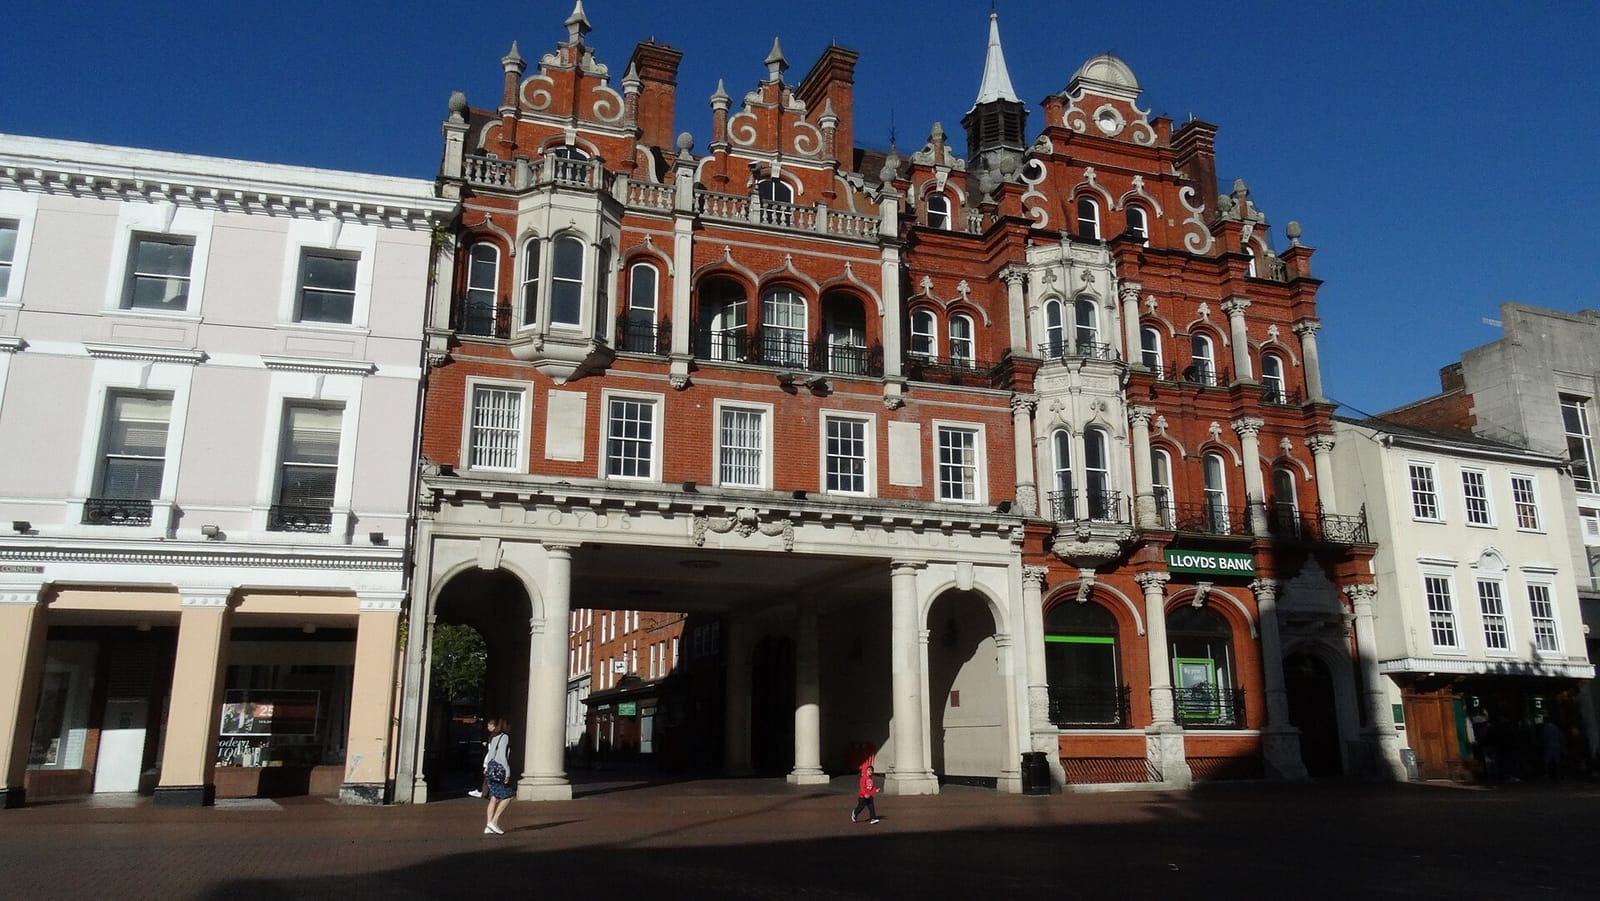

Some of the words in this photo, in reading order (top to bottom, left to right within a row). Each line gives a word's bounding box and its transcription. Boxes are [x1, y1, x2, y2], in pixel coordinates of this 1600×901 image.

[500, 507, 632, 530] LLOYDS
[849, 526, 960, 548] AVENUE
[1170, 554, 1217, 569] LLOYDS
[1218, 557, 1254, 571] BANK
